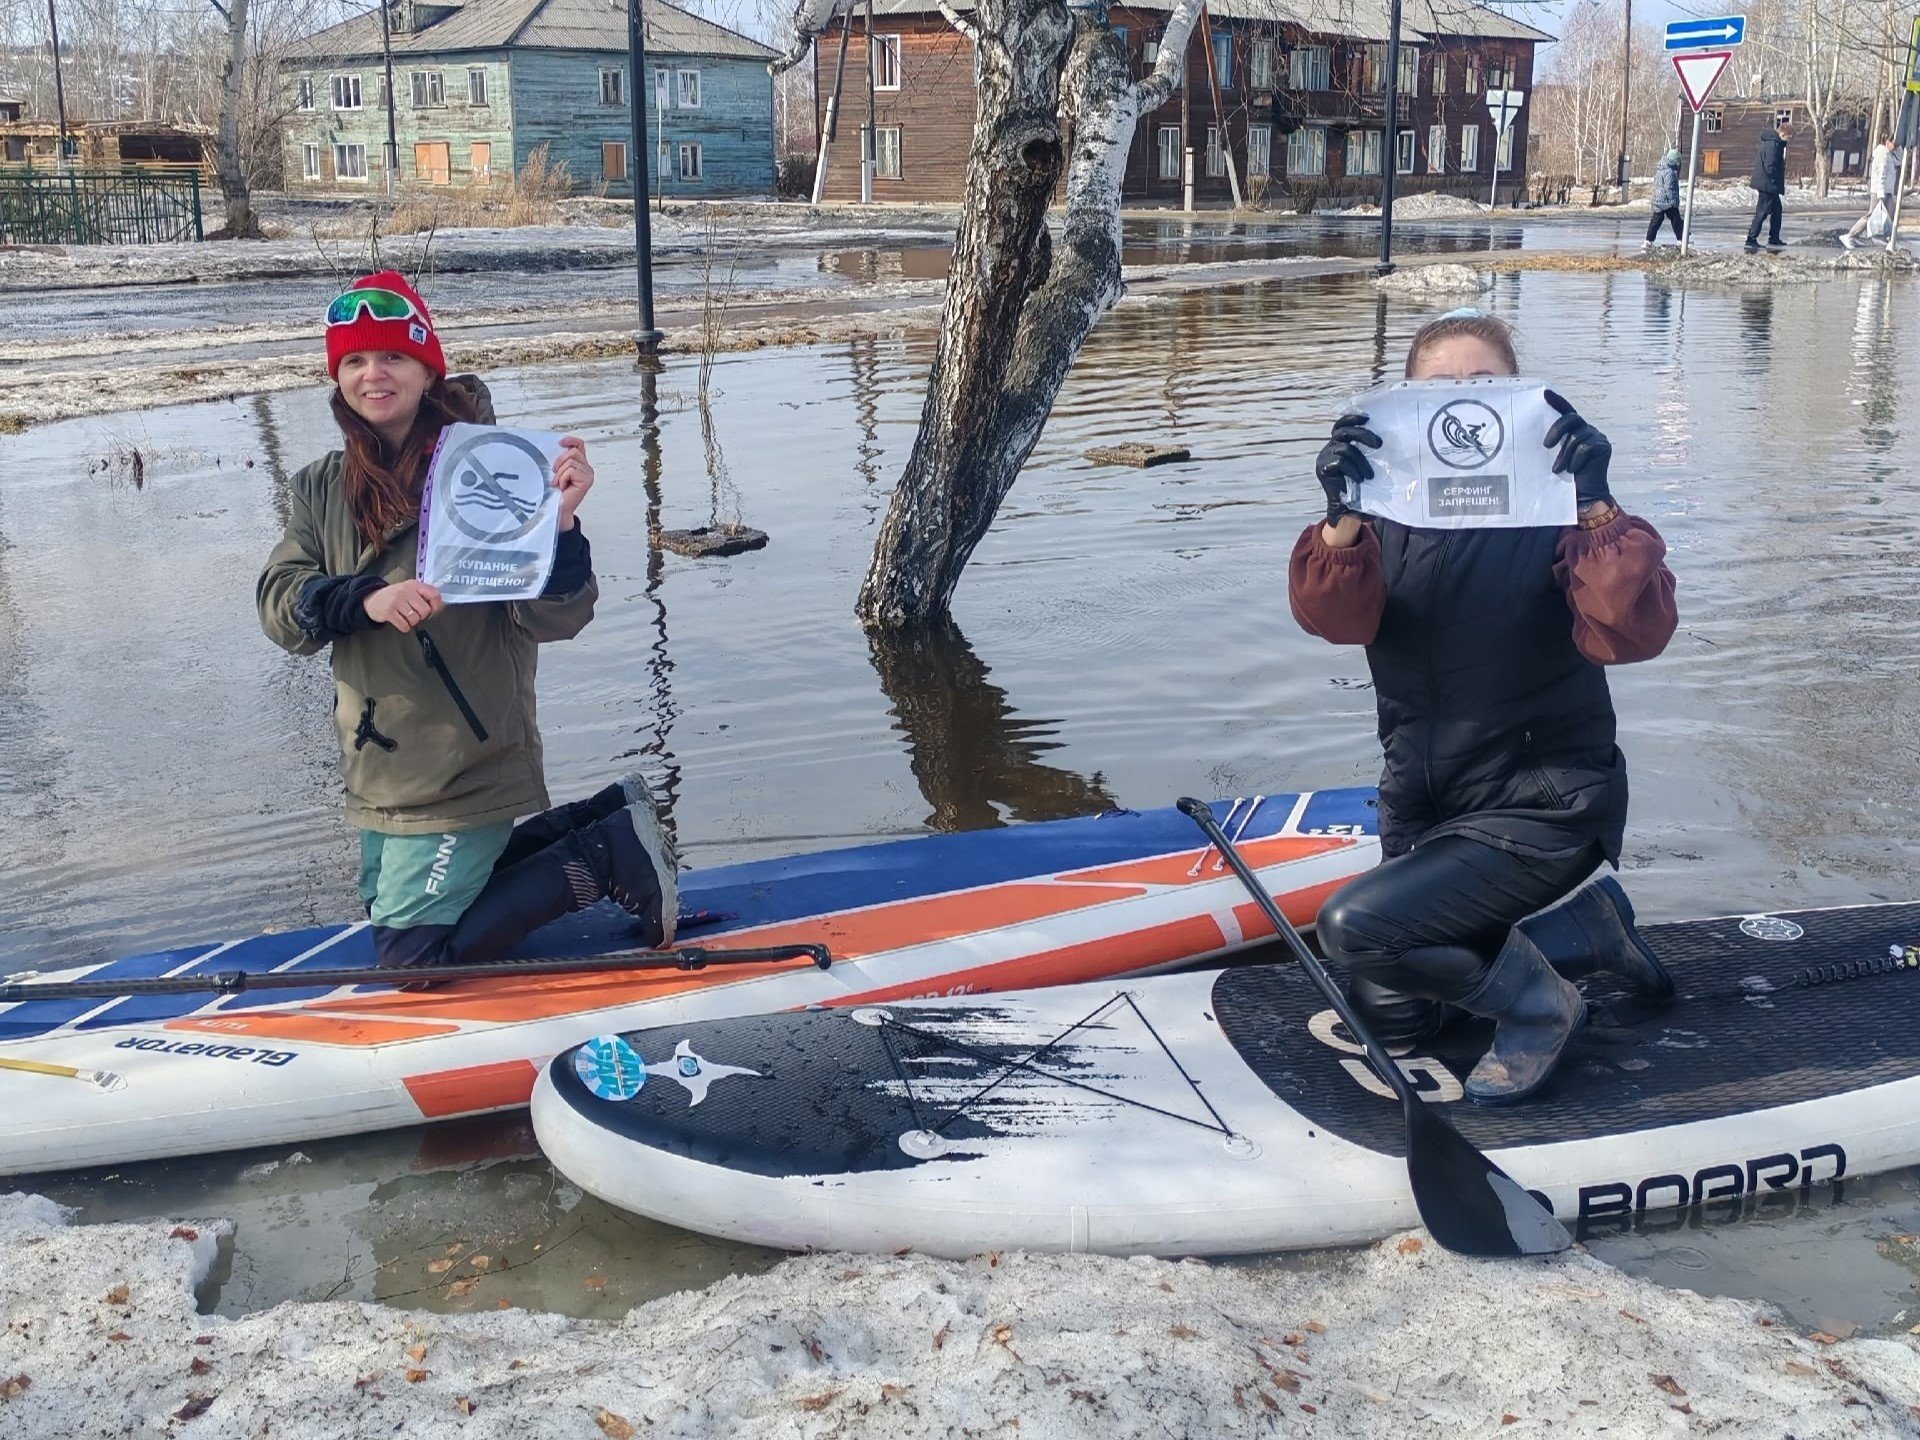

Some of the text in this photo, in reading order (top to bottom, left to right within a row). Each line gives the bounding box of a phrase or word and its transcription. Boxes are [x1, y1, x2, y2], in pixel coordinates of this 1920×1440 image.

[1443, 485, 1492, 496] СЕРФИНГ
[1438, 496, 1498, 507] ЗАПРЕЩЕН!
[458, 558, 518, 572] КУПАНИЕ
[444, 574, 525, 588] ЗАПРЕЩЕНО!
[425, 834, 457, 895] FINN
[1577, 1143, 1847, 1217] BOARD
